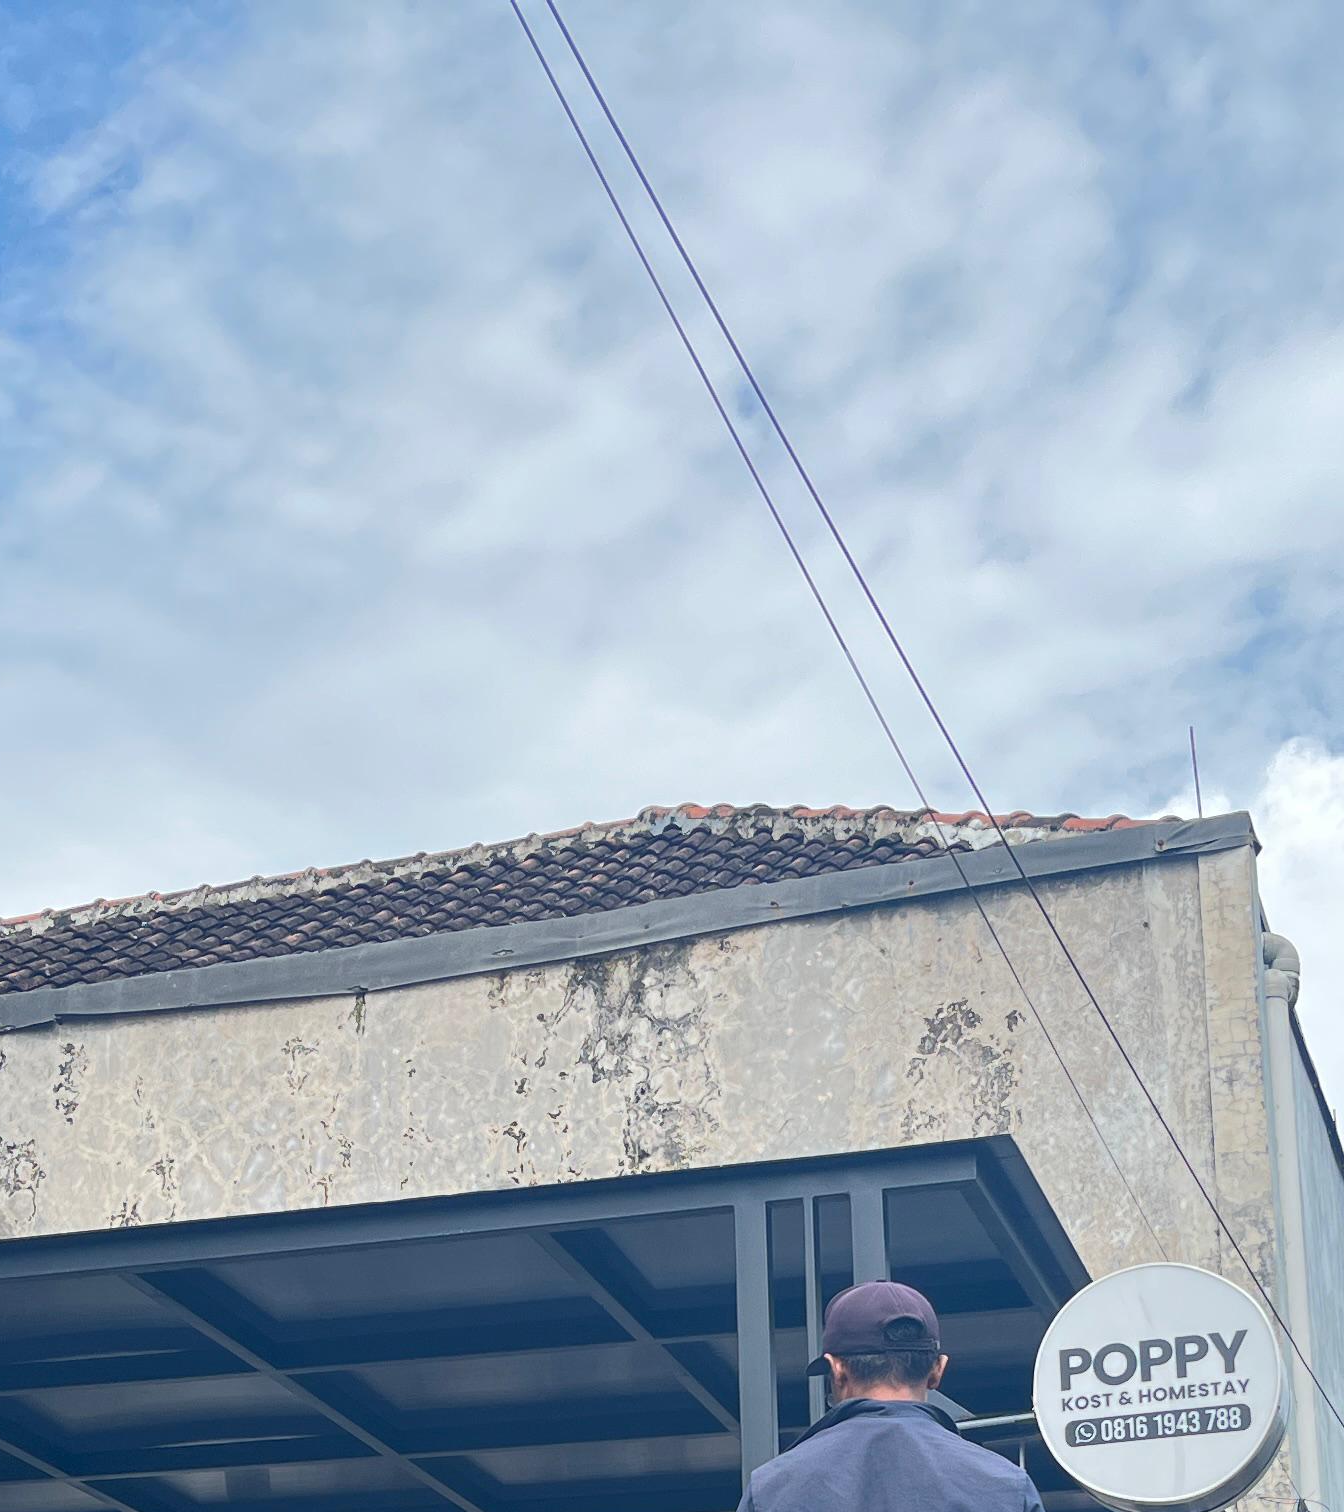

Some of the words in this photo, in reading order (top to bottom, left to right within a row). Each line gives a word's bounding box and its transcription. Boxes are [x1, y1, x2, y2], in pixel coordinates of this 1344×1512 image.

[1059, 1329, 1248, 1391] POPPY
[1061, 1393, 1112, 1412] KOST
[1118, 1391, 1133, 1405] &
[1138, 1379, 1251, 1405] HOMESTAY
[1100, 1418, 1148, 1443] 0816
[1153, 1412, 1201, 1438] 1943
[1206, 1407, 1242, 1431] 788
